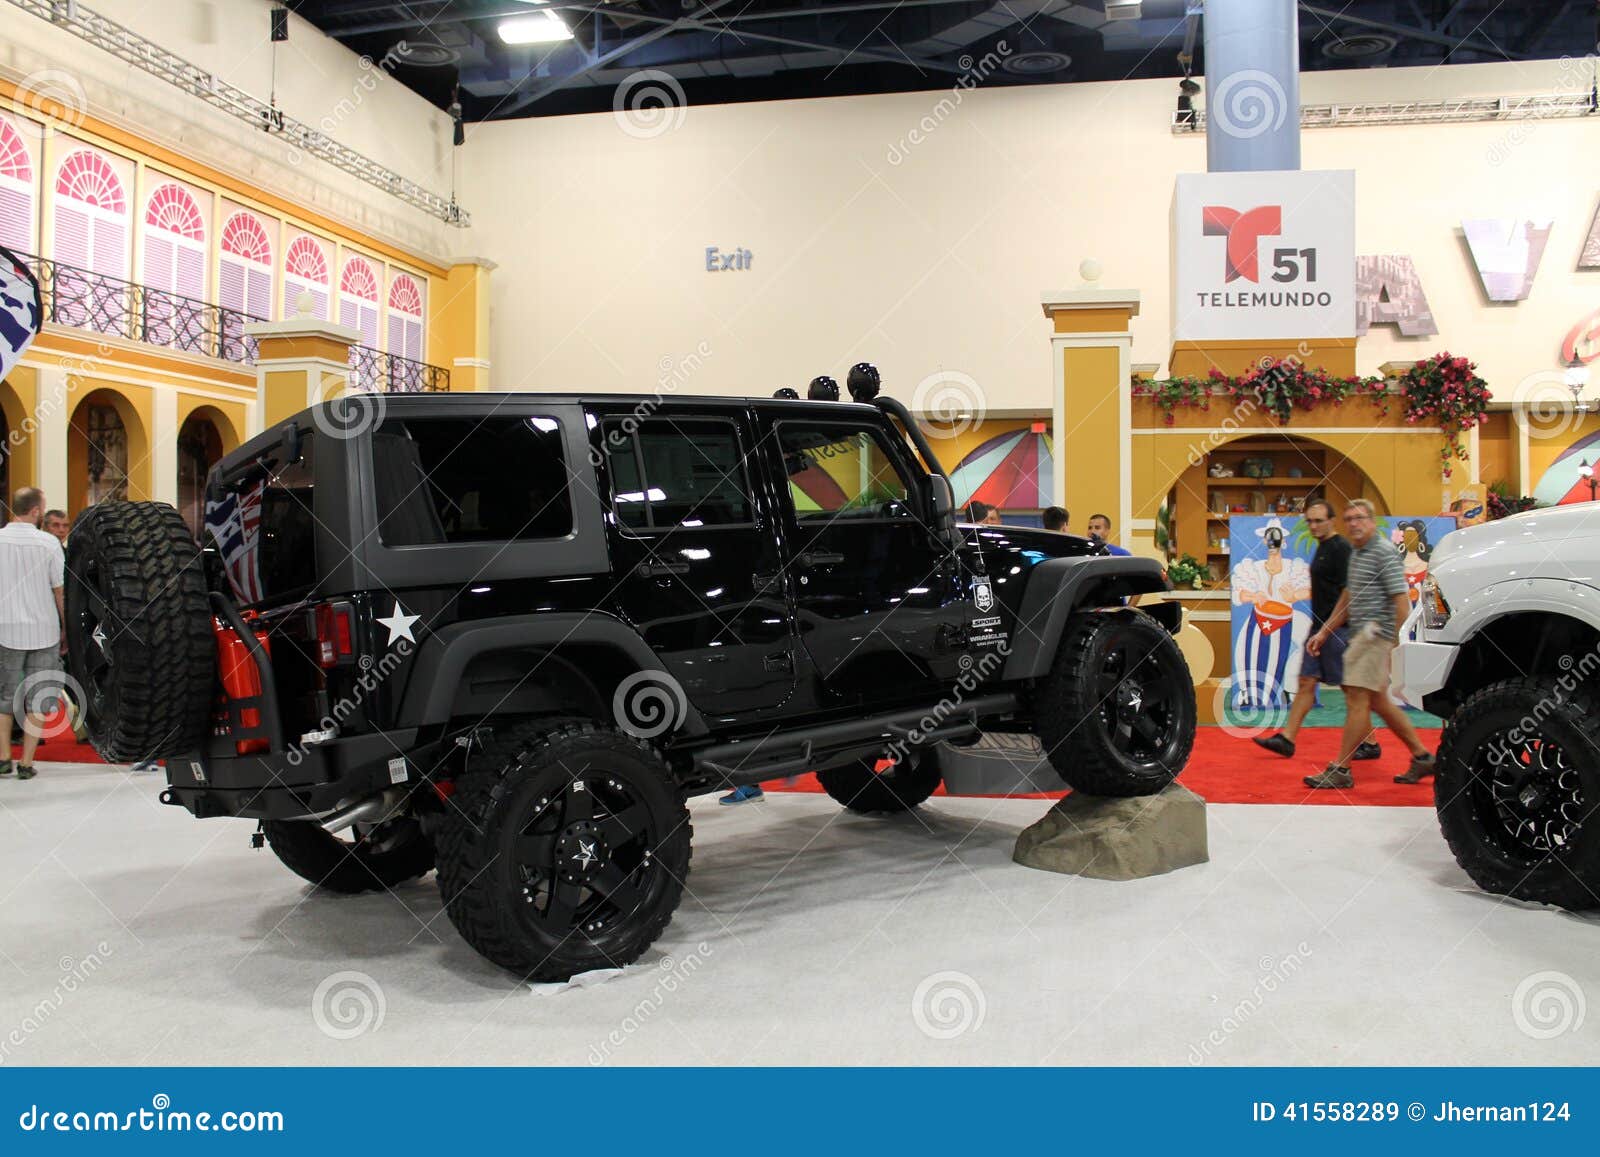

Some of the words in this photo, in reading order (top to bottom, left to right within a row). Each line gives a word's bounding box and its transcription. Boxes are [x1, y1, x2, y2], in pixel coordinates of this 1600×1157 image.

[705, 246, 753, 272] Exit
[1271, 247, 1317, 284] 51
[1197, 291, 1332, 308] TELEMUNDO
[973, 618, 1001, 626] SPORT
[969, 632, 1008, 642] WRANGLER
